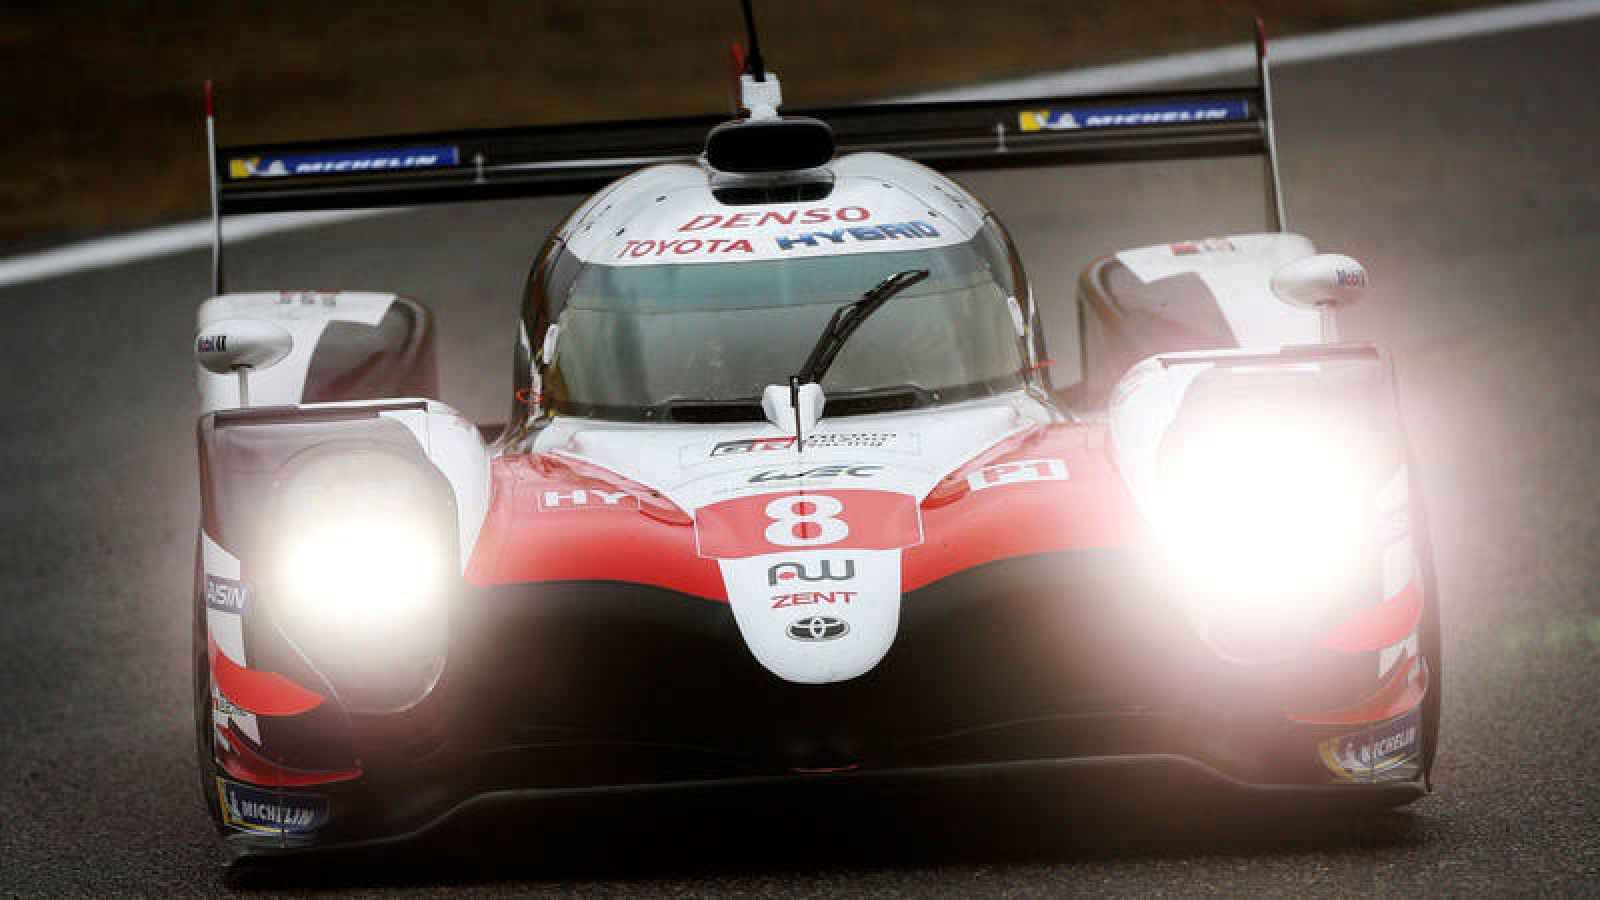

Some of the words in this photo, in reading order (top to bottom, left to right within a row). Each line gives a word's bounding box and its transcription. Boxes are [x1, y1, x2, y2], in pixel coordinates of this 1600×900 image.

[678, 206, 871, 232] DENSO
[617, 239, 754, 258] TOYOTA
[774, 221, 940, 250] HYBRID
[544, 489, 631, 507] HY
[764, 495, 849, 547] 8
[771, 591, 859, 609] ZENT
